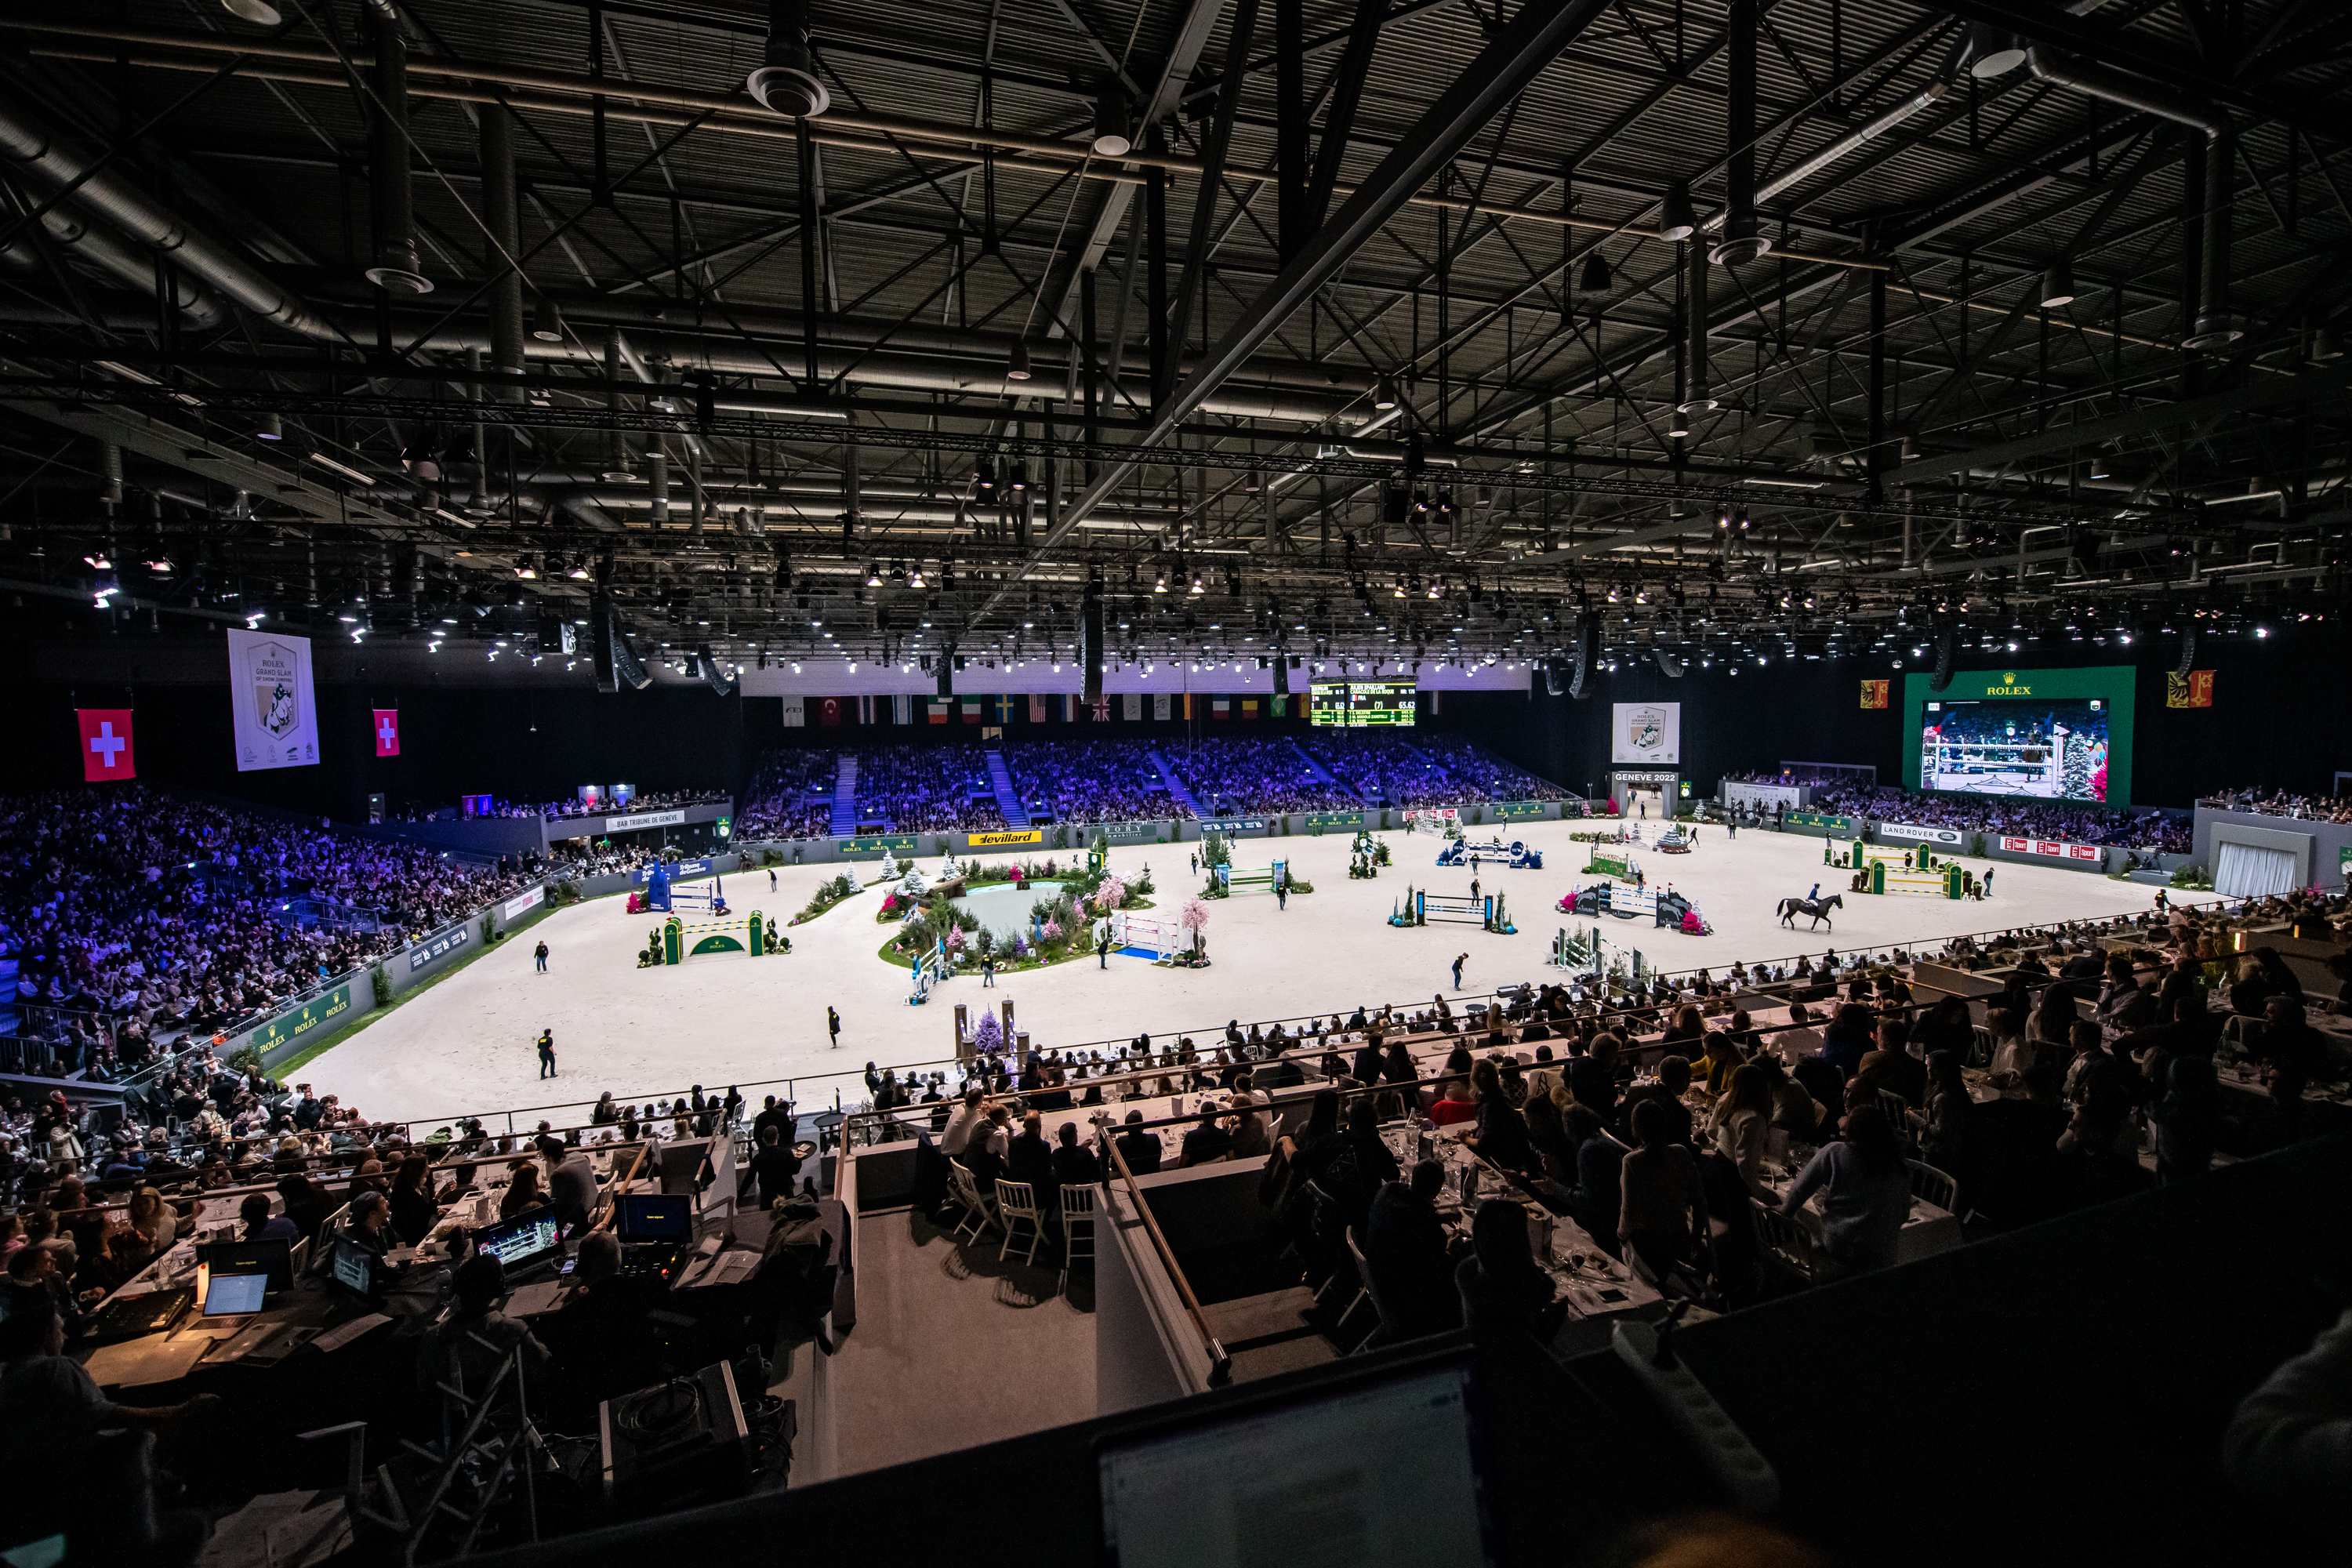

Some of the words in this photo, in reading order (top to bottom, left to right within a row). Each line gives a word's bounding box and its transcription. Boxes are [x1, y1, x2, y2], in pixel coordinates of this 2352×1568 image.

[1987, 687, 2031, 695] ROLEX
[1374, 701, 1383, 710] (7)
[1399, 701, 1415, 710] 65.62
[629, 818, 651, 826] TRIBUNE
[659, 814, 677, 822] GENÈVE
[979, 832, 1032, 844] devillard
[1907, 829, 1934, 838] ROVER
[2014, 840, 2027, 849] Sport
[2047, 844, 2060, 853] Sport
[2081, 848, 2094, 857] Sport
[326, 1000, 347, 1018] ROLEX
[294, 1016, 318, 1035] ROLEX
[260, 1033, 285, 1054] ROLEX
